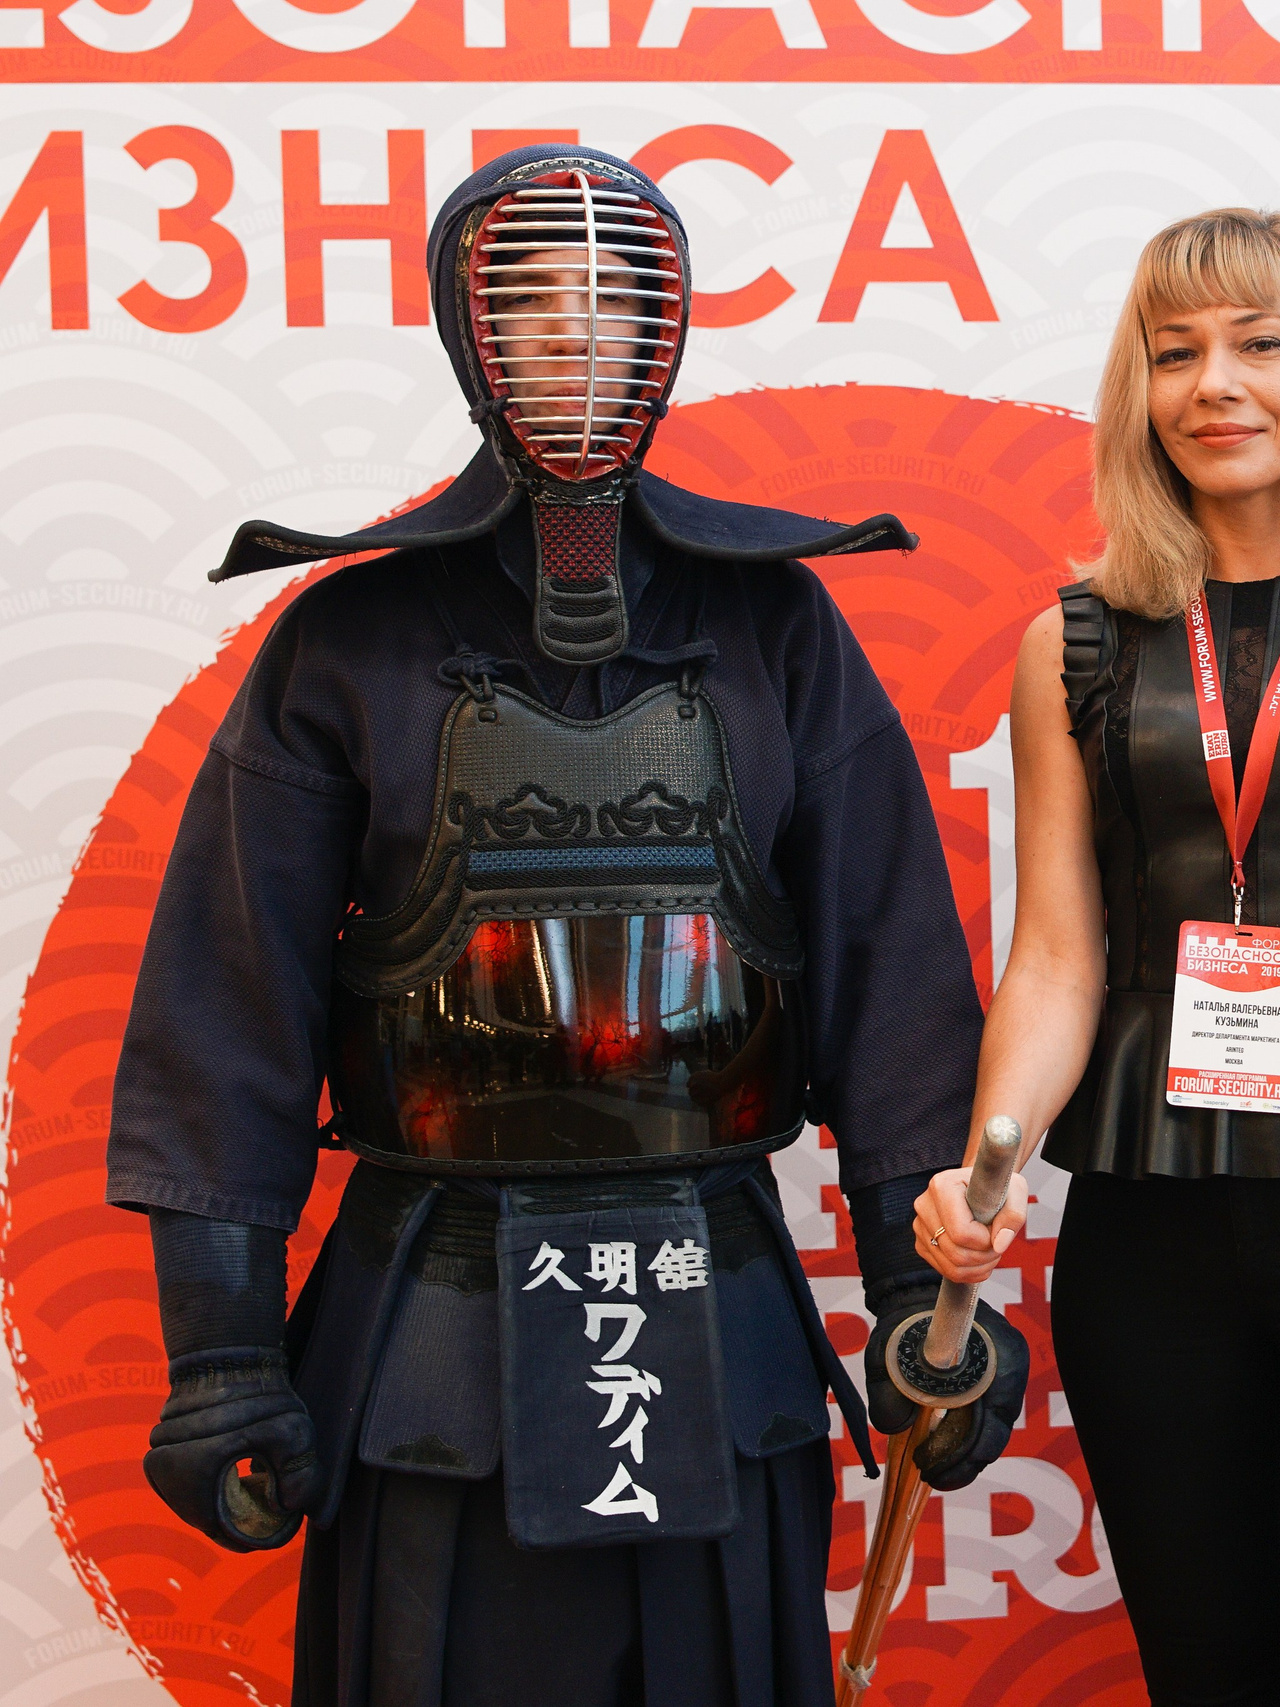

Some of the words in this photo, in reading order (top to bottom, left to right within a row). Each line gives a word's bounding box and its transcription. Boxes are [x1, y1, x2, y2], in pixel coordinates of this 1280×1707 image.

[759, 453, 986, 499] FORUM-SECURITY.RU
[1206, 734, 1215, 758] EKAT
[1213, 733, 1222, 757] ERIN
[1220, 731, 1229, 755] BURG
[1187, 959, 1249, 975] БИЗНЕСА
[1193, 1000, 1230, 1012] НАТАЛЬЯ
[1215, 1015, 1259, 1029] КУЗЬМИНА
[1191, 1030, 1215, 1038] ДИРЕКТОР
[1215, 1032, 1251, 1042] ДЕПАРТАМЕНТА
[1250, 1035, 1280, 1044] МАРКЕТИНГА
[1224, 1057, 1244, 1066] МОСКВА
[1198, 1070, 1236, 1080] РАСШИРЕННАЯ
[1236, 1073, 1268, 1083] ПРОГРАММА
[1203, 1099, 1230, 1107] kaspersky
[580, 1302, 662, 1523] ワディム
